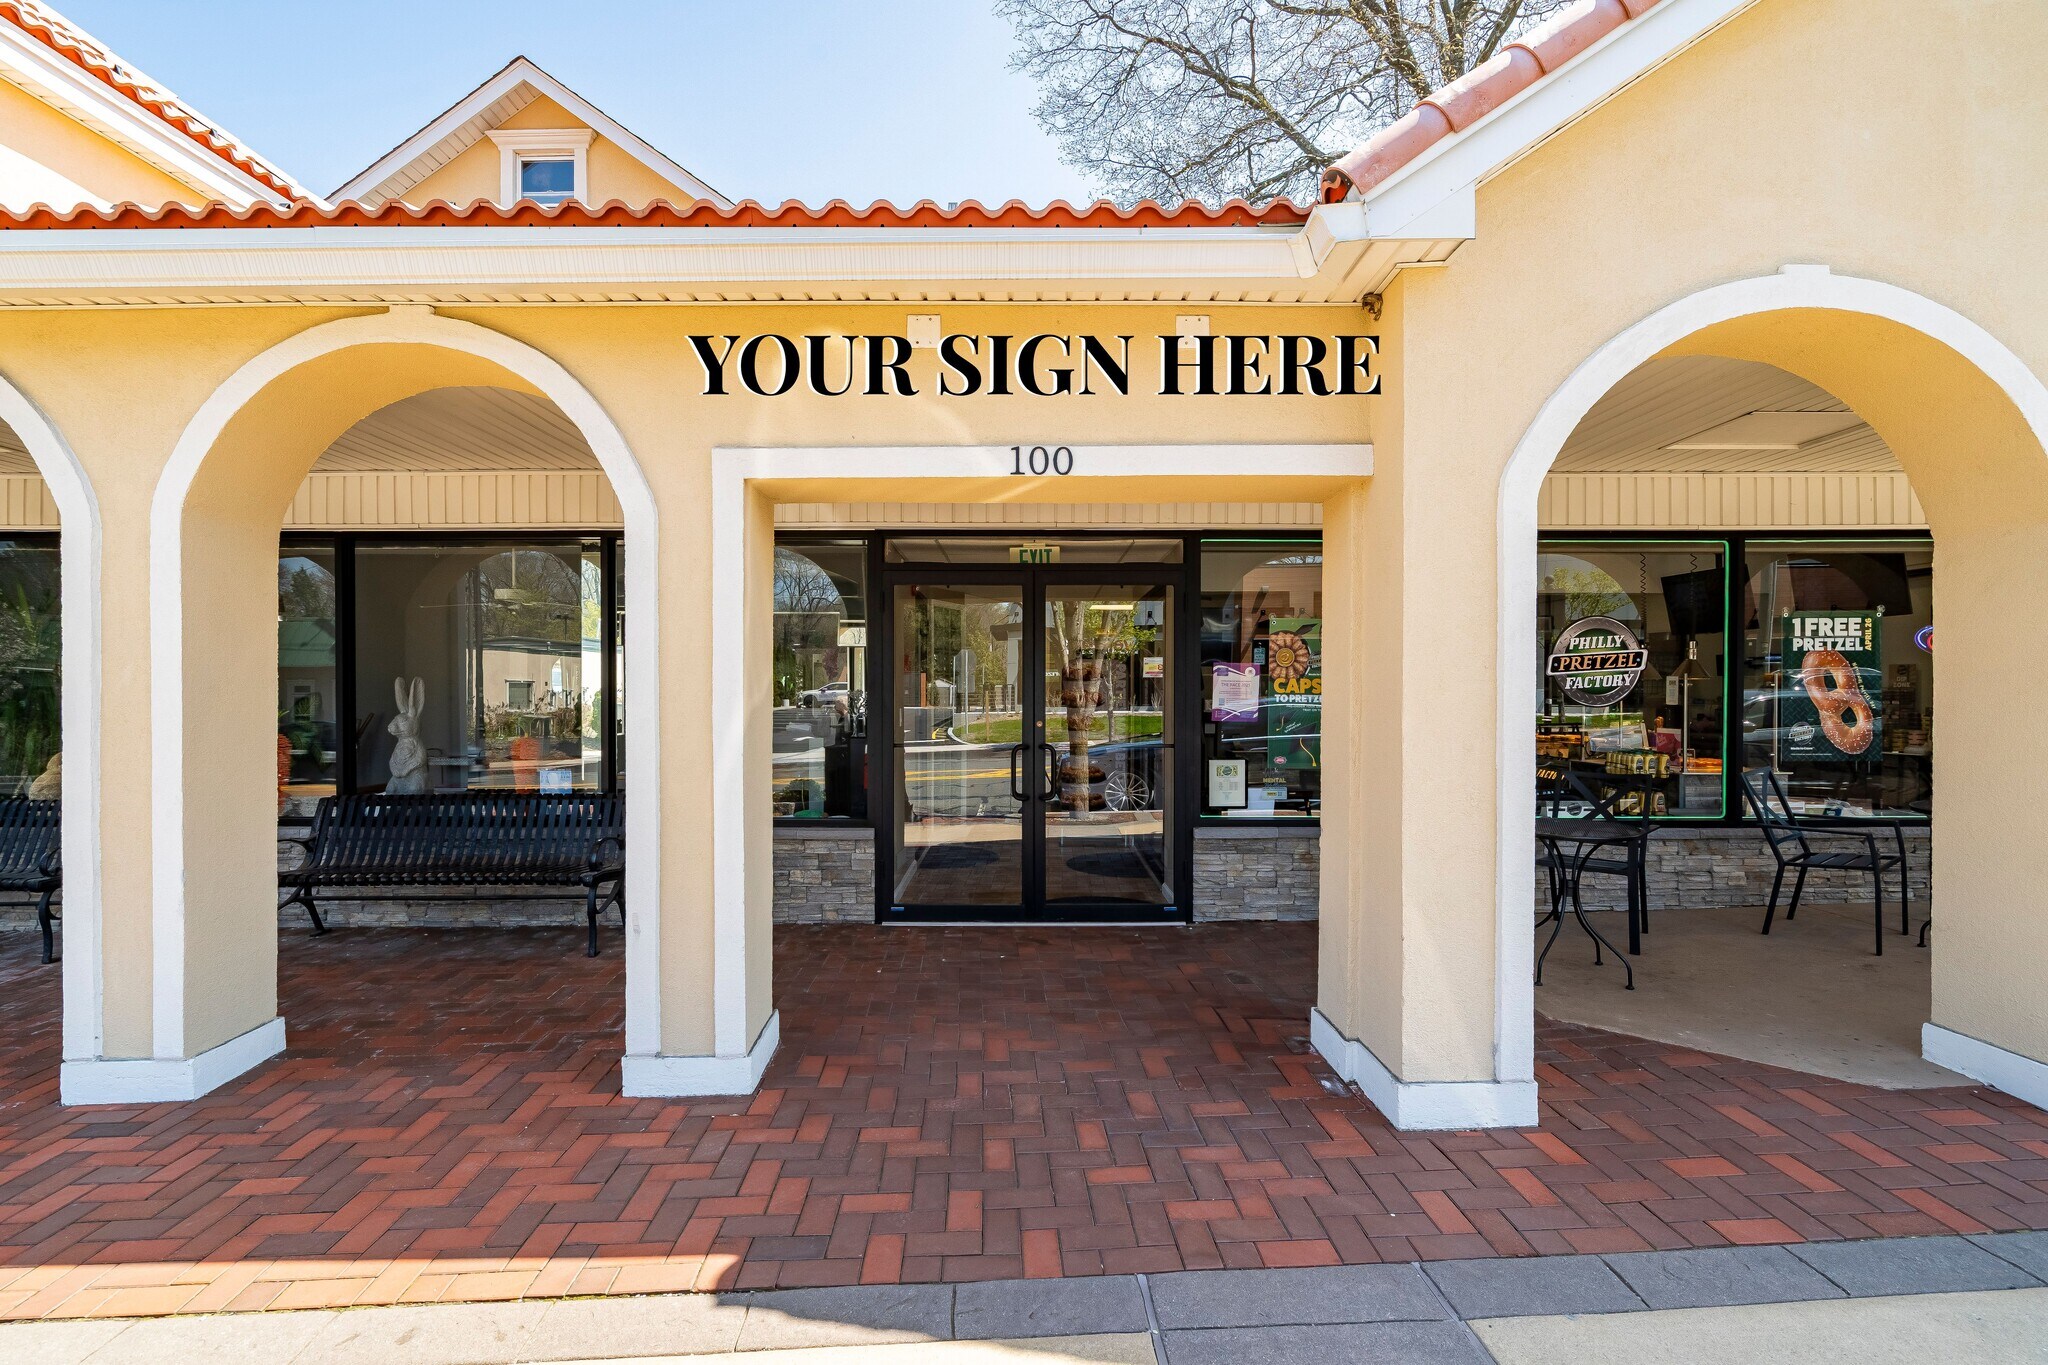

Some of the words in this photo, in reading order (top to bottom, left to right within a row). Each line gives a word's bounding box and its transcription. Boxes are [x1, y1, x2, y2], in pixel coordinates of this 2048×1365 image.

[1010, 445, 1074, 476] 100
[1792, 617, 1801, 637] 1
[1805, 617, 1862, 637] FREE
[1569, 634, 1625, 650] PHILLY
[1792, 637, 1864, 652] PRETZEL
[1864, 628, 1873, 651] APRIL
[1558, 652, 1638, 672] PRETZEL
[1273, 677, 1321, 694] CAPS
[1564, 673, 1635, 690] FACTORY
[1275, 694, 1289, 703] TO
